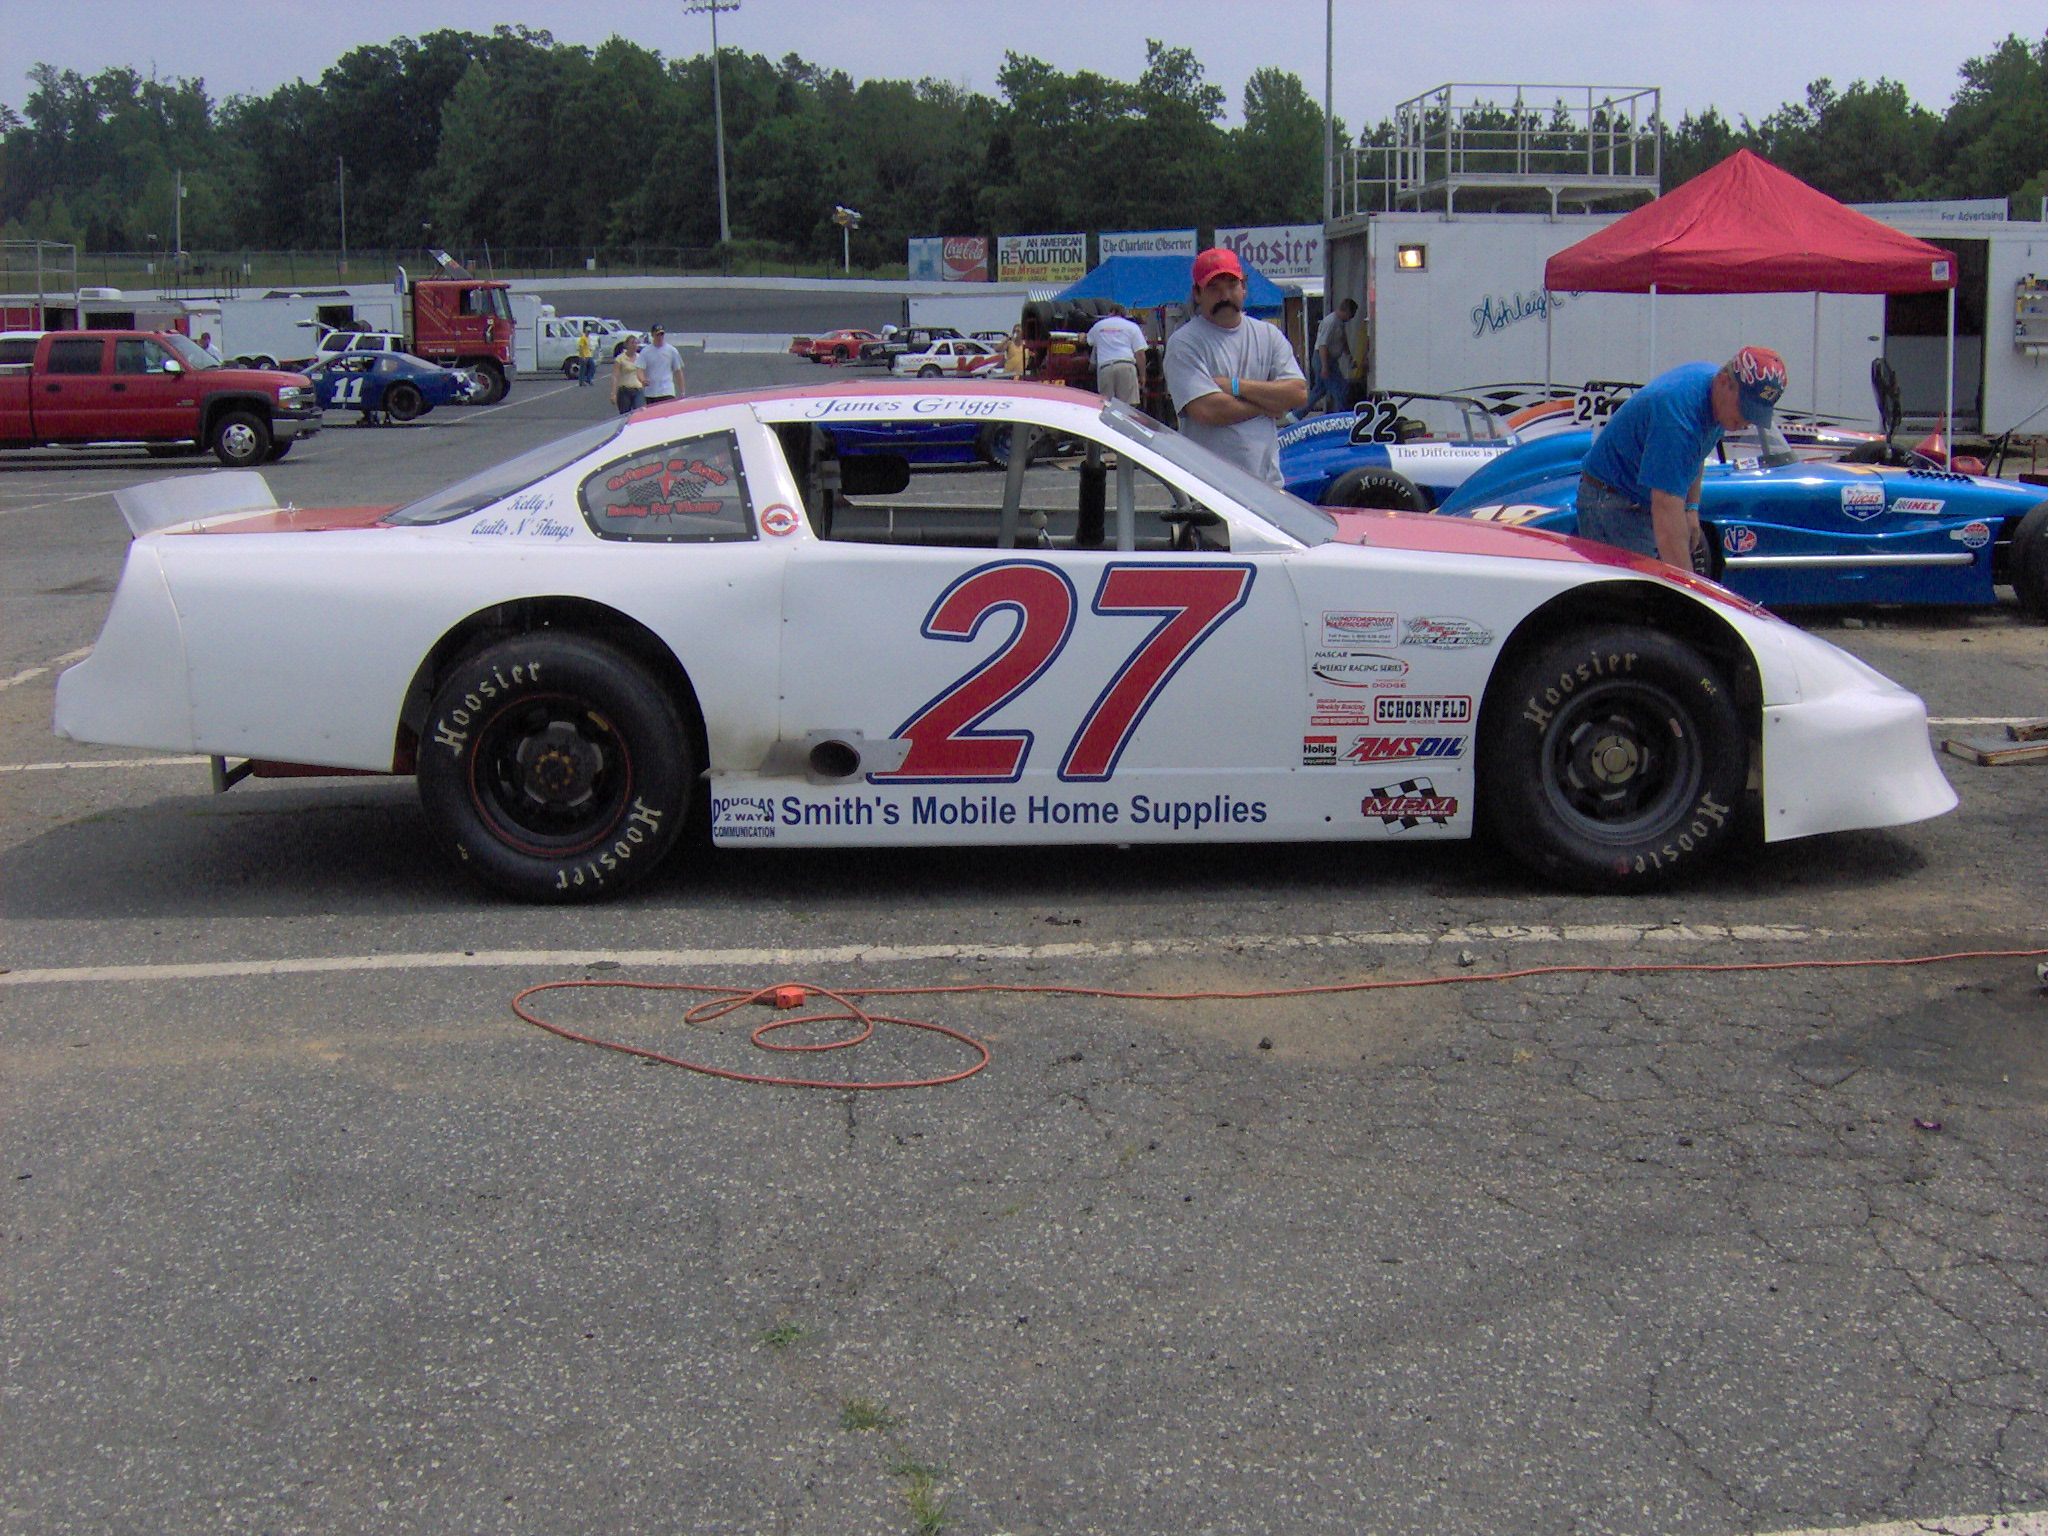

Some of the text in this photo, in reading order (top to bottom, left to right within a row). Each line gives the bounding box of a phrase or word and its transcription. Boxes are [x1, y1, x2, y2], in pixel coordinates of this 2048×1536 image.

[1941, 211, 1954, 221] For
[1958, 211, 2004, 222] Advertising
[1026, 236, 1082, 248] AN AMERICAN
[1102, 236, 1193, 253] The Charlotte Observer
[1222, 230, 1319, 265] Hoosier
[1001, 248, 1082, 265] REVOLUTION
[1289, 266, 1311, 274] TIRE
[330, 376, 364, 404] 11
[805, 397, 1013, 419] James Griggs
[1277, 416, 1360, 448] THAMPTONGROUP
[1351, 401, 1399, 445] 22
[1396, 447, 1418, 458] The
[1421, 447, 1480, 458] Difference
[1483, 447, 1493, 458] is
[1360, 475, 1412, 499] Hoosier
[507, 493, 554, 515] Kelly's
[1847, 494, 1881, 505] LUCAS
[530, 517, 575, 542] Things
[866, 557, 1258, 785] 27
[1319, 664, 1403, 672] WEEKLY RACING SERIES
[1523, 651, 1637, 734] Hoosier
[434, 661, 541, 756] Hoosier
[1340, 703, 1366, 711] Racing
[1378, 700, 1467, 718] SCHOENFELD
[1303, 744, 1337, 757] Holley
[1347, 737, 1463, 762] AMSOIL
[712, 797, 775, 824] DOUGLAS
[724, 813, 732, 822] 2
[781, 794, 1267, 830] Smith's Mobile Home Supplies
[713, 825, 776, 838] COMMUNICATION
[556, 796, 664, 890] Hoosier
